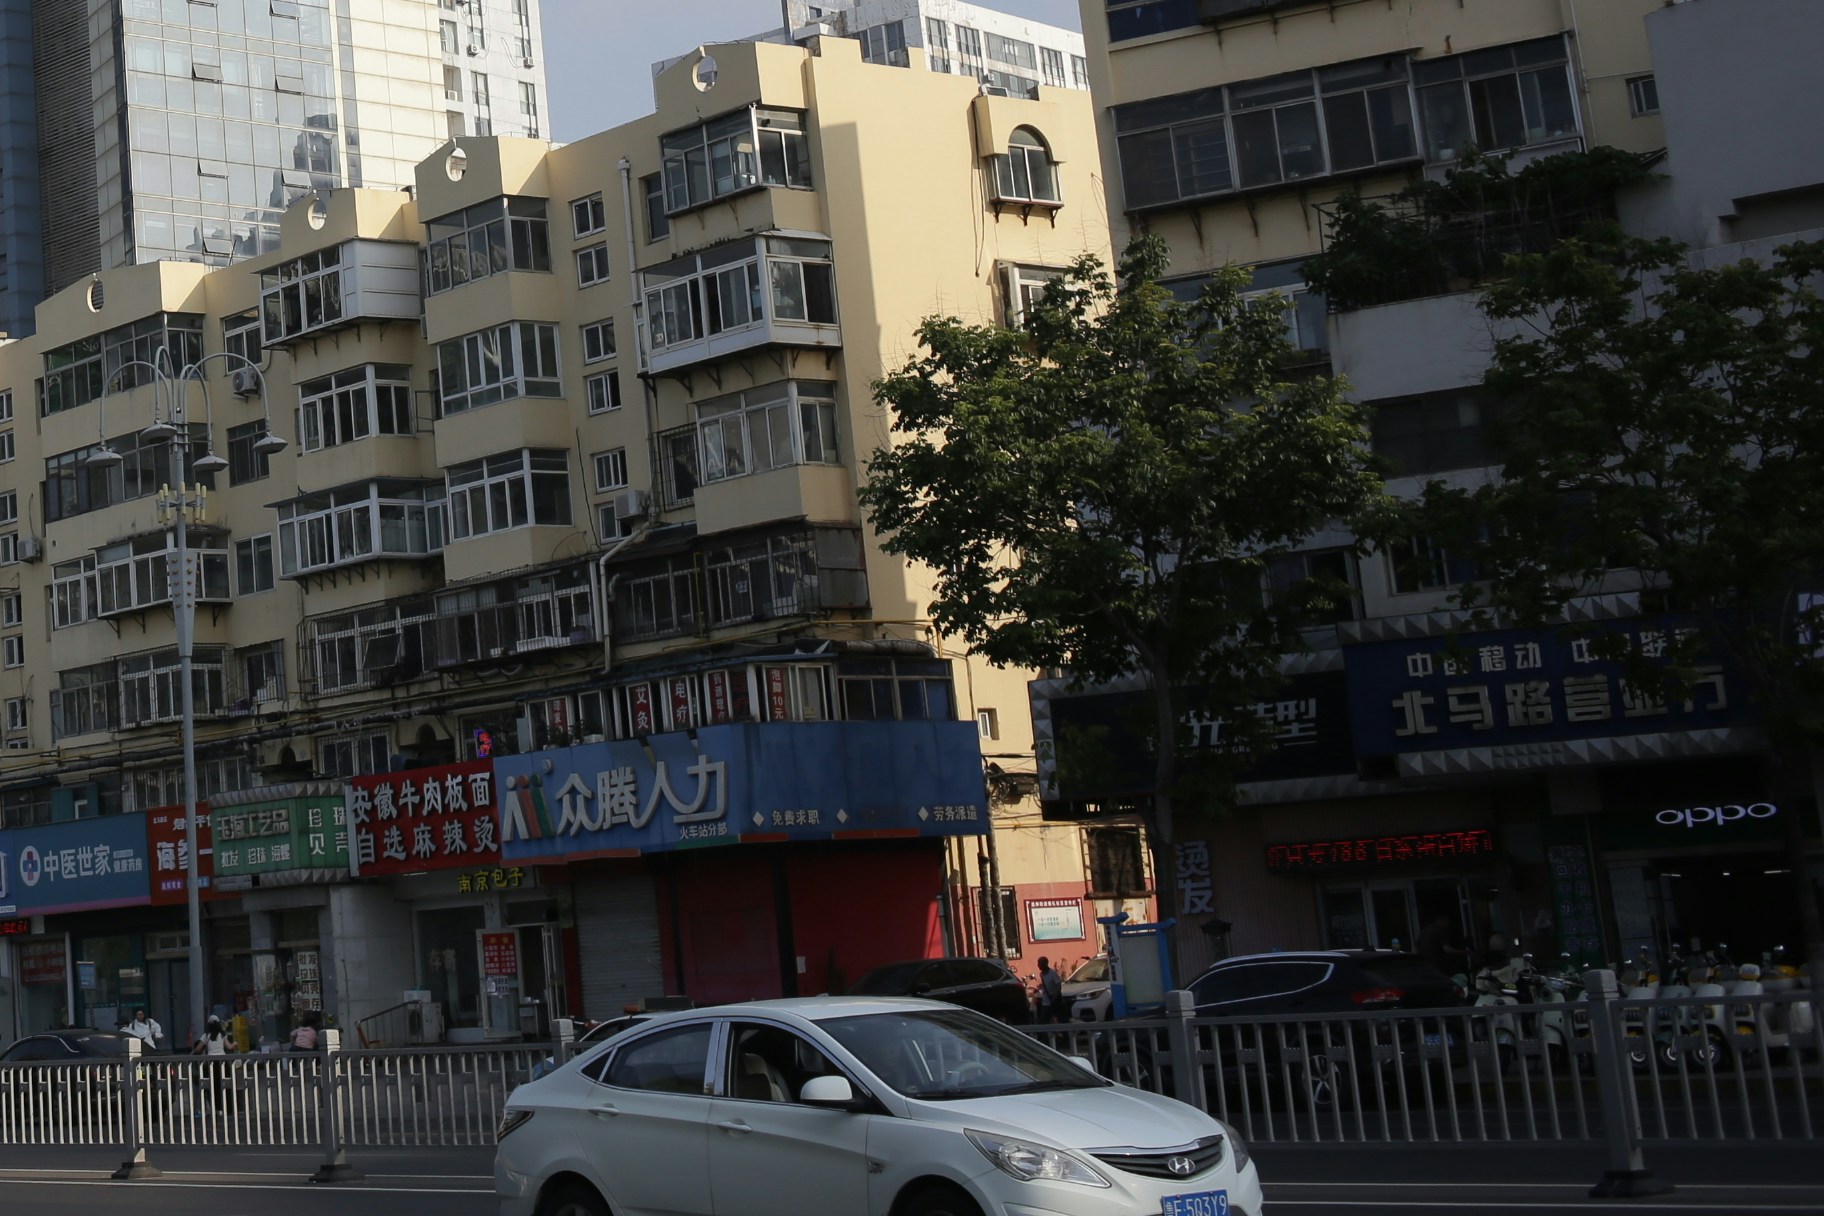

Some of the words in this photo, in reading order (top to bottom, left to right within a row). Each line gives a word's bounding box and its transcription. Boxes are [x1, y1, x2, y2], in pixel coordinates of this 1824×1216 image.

[634, 685, 649, 730] 艾灸
[674, 679, 688, 724] 电疗
[351, 771, 492, 824] 安徽牛肉板面
[554, 753, 729, 837] 众腾人力
[307, 805, 345, 828] 珍珠
[771, 809, 821, 827] 免费求职
[932, 805, 979, 822] 劳务派遣
[308, 831, 348, 855] 贝壳
[356, 814, 499, 866] 自选麻辣烫
[679, 823, 728, 840] 火车站分部
[43, 843, 112, 882] 中医世家
[456, 866, 525, 894] 南京包子
